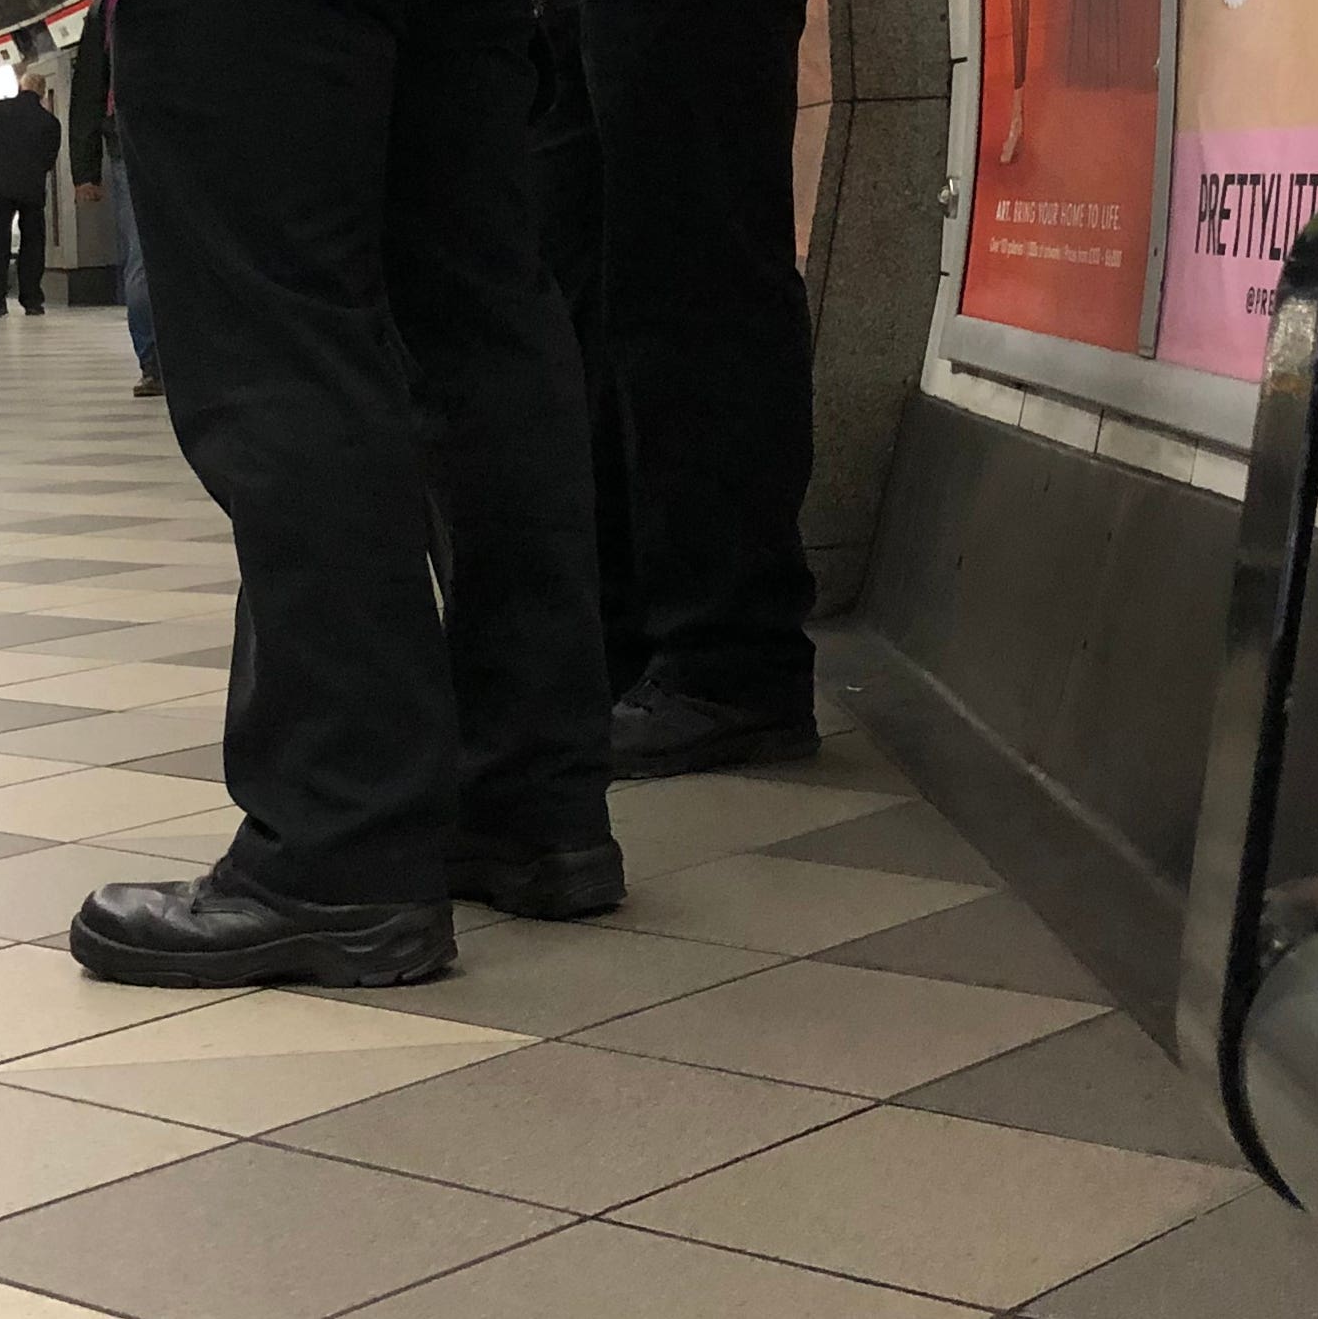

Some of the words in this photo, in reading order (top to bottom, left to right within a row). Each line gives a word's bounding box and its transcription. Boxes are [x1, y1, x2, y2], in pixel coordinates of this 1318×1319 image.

[1013, 200, 1036, 224] BRING
[1037, 202, 1059, 226] YOUR
[1060, 202, 1085, 228] HOME
[1087, 203, 1100, 229] TO
[1100, 204, 1122, 231] LIFE.
